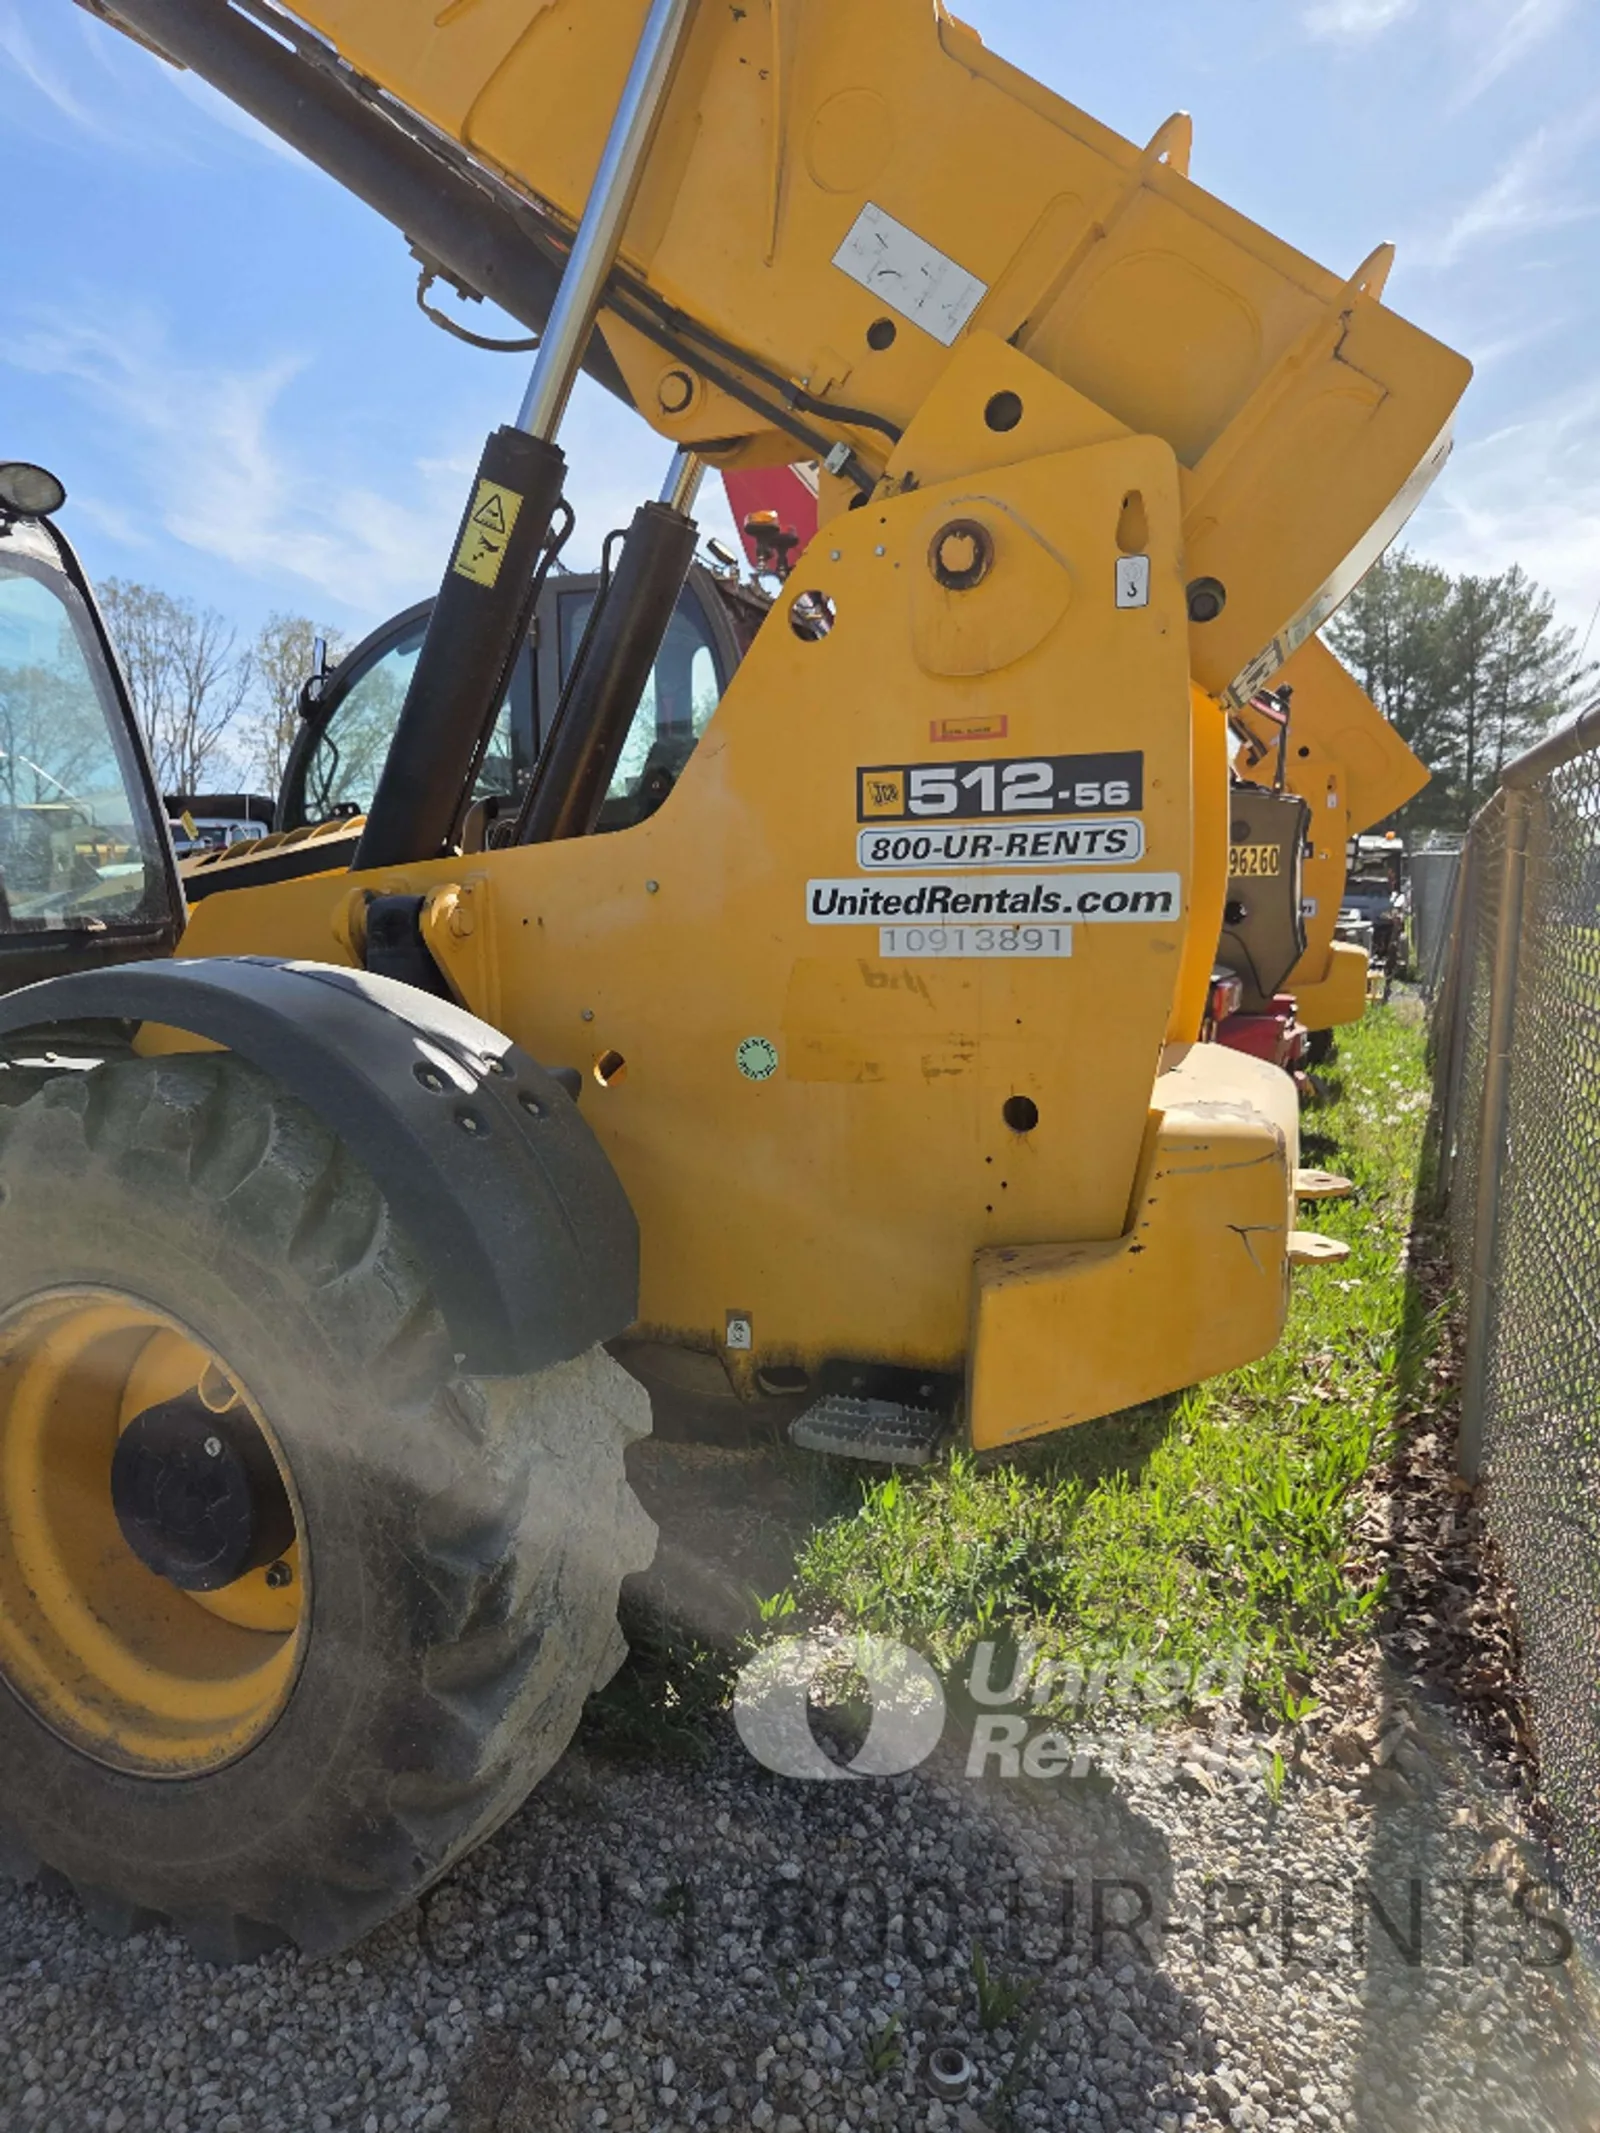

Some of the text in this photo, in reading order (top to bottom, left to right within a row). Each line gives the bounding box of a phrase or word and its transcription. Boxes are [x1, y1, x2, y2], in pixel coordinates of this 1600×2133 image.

[908, 762, 1130, 815] 512-56
[871, 828, 1128, 861] 800-UR-RENTS
[1230, 848, 1278, 875] 96260
[812, 885, 1172, 917] UnitedRentals.com
[884, 928, 1062, 952] 10913891
